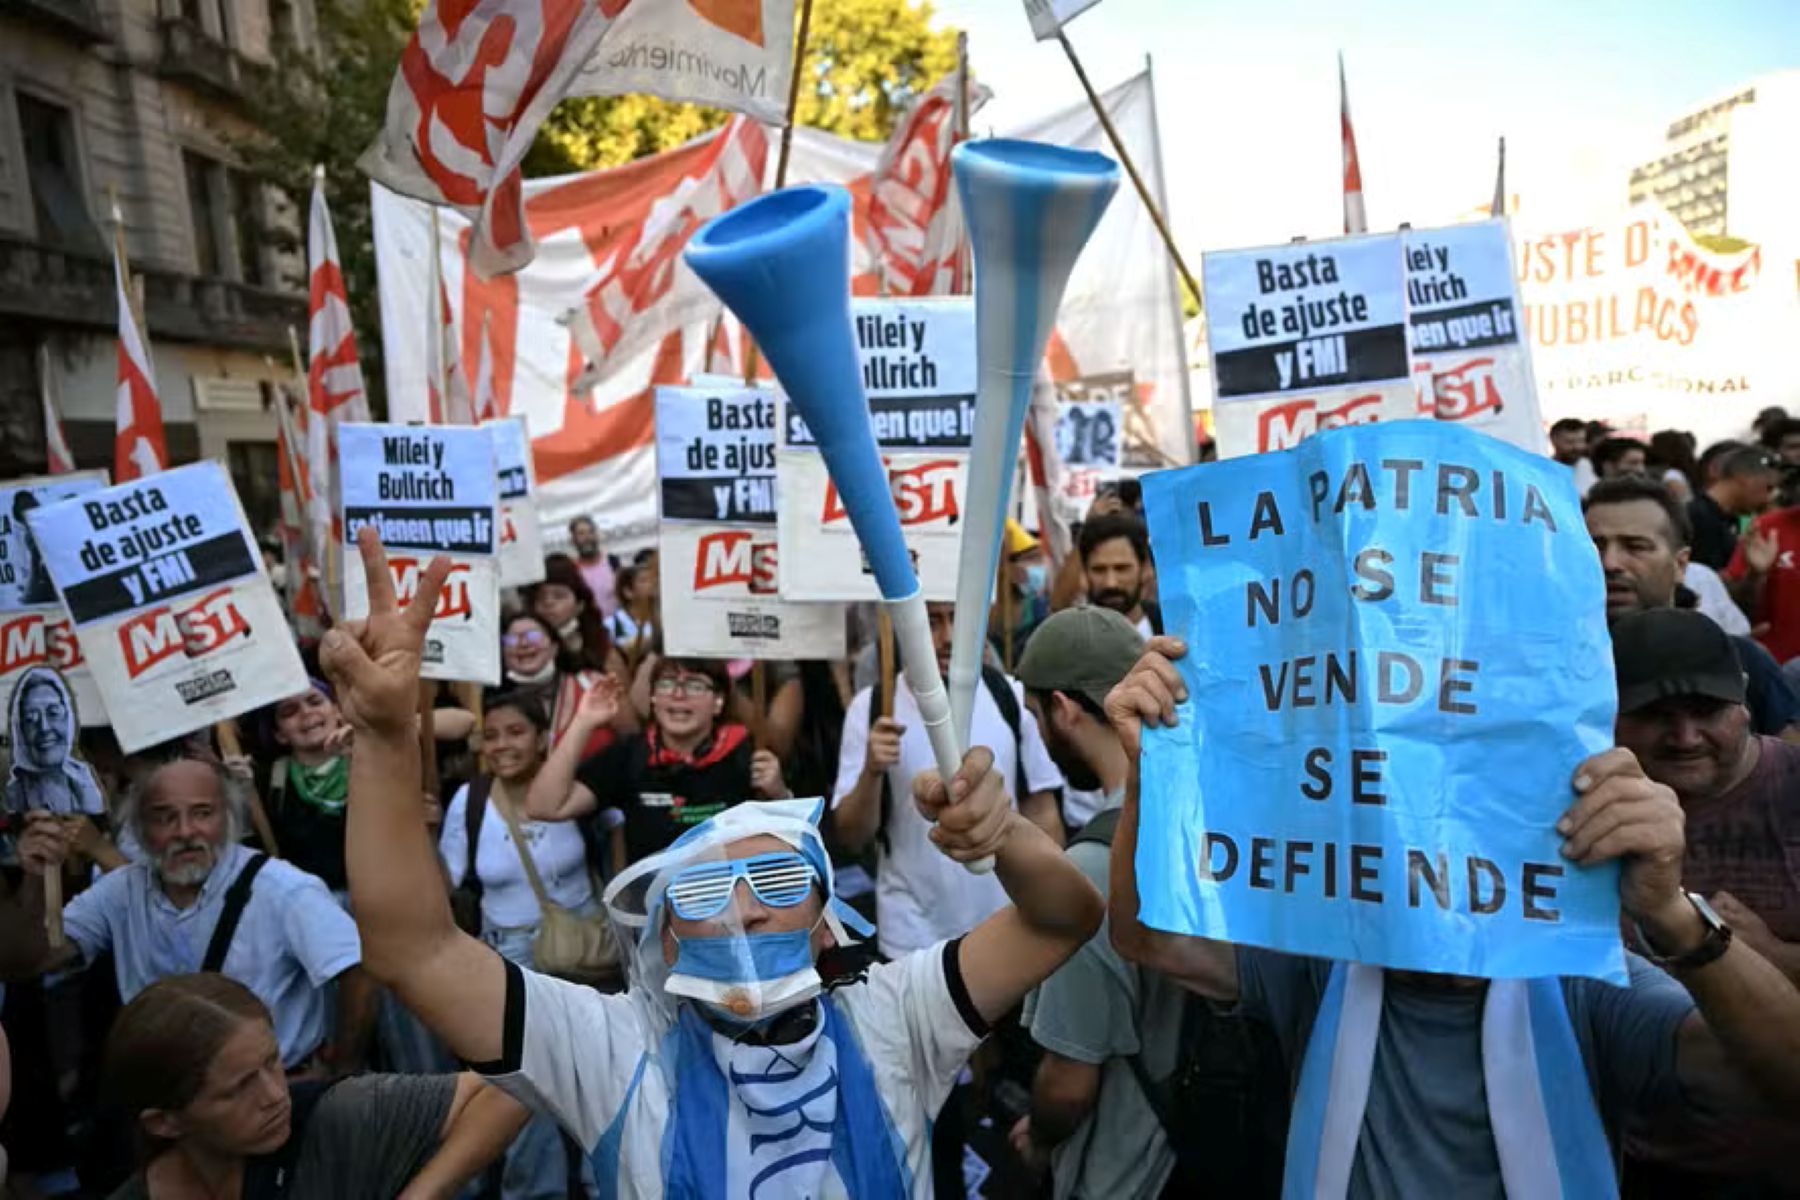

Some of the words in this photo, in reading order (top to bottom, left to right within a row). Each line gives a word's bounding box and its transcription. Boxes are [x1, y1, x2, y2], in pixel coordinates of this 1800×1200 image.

[1256, 253, 1340, 294] Basta
[1406, 242, 1434, 272] lei
[1434, 245, 1449, 273] y
[1407, 272, 1468, 306] llrich
[911, 320, 926, 354] y
[1241, 303, 1277, 339] de
[1282, 292, 1369, 337] ajuste
[1447, 313, 1493, 347] que
[1491, 304, 1512, 336] ir
[1274, 351, 1294, 389] y
[1296, 335, 1349, 380] FMI
[707, 397, 776, 430] Basta
[908, 406, 958, 445] que
[382, 436, 430, 465] Milei
[433, 441, 445, 471] y
[687, 438, 718, 471] de
[725, 437, 777, 475] ajus
[83, 486, 169, 532] Basta
[378, 472, 454, 501] Bullrich
[713, 484, 731, 520] y
[1198, 489, 1285, 547] LA
[1307, 458, 1558, 534] PATRIA
[80, 540, 118, 572] de
[119, 513, 204, 562] ajuste
[433, 518, 474, 549] que
[473, 511, 490, 544] ir
[121, 571, 145, 606] y
[139, 550, 198, 596] FMI
[698, 533, 777, 591] MS
[1246, 567, 1317, 628] NO
[1350, 547, 1461, 607] SE
[2, 616, 80, 672] MS
[121, 592, 246, 674] MST
[1258, 648, 1481, 715] VENDE
[1300, 746, 1390, 806] SE
[1199, 831, 1567, 923] DEFIENDE
